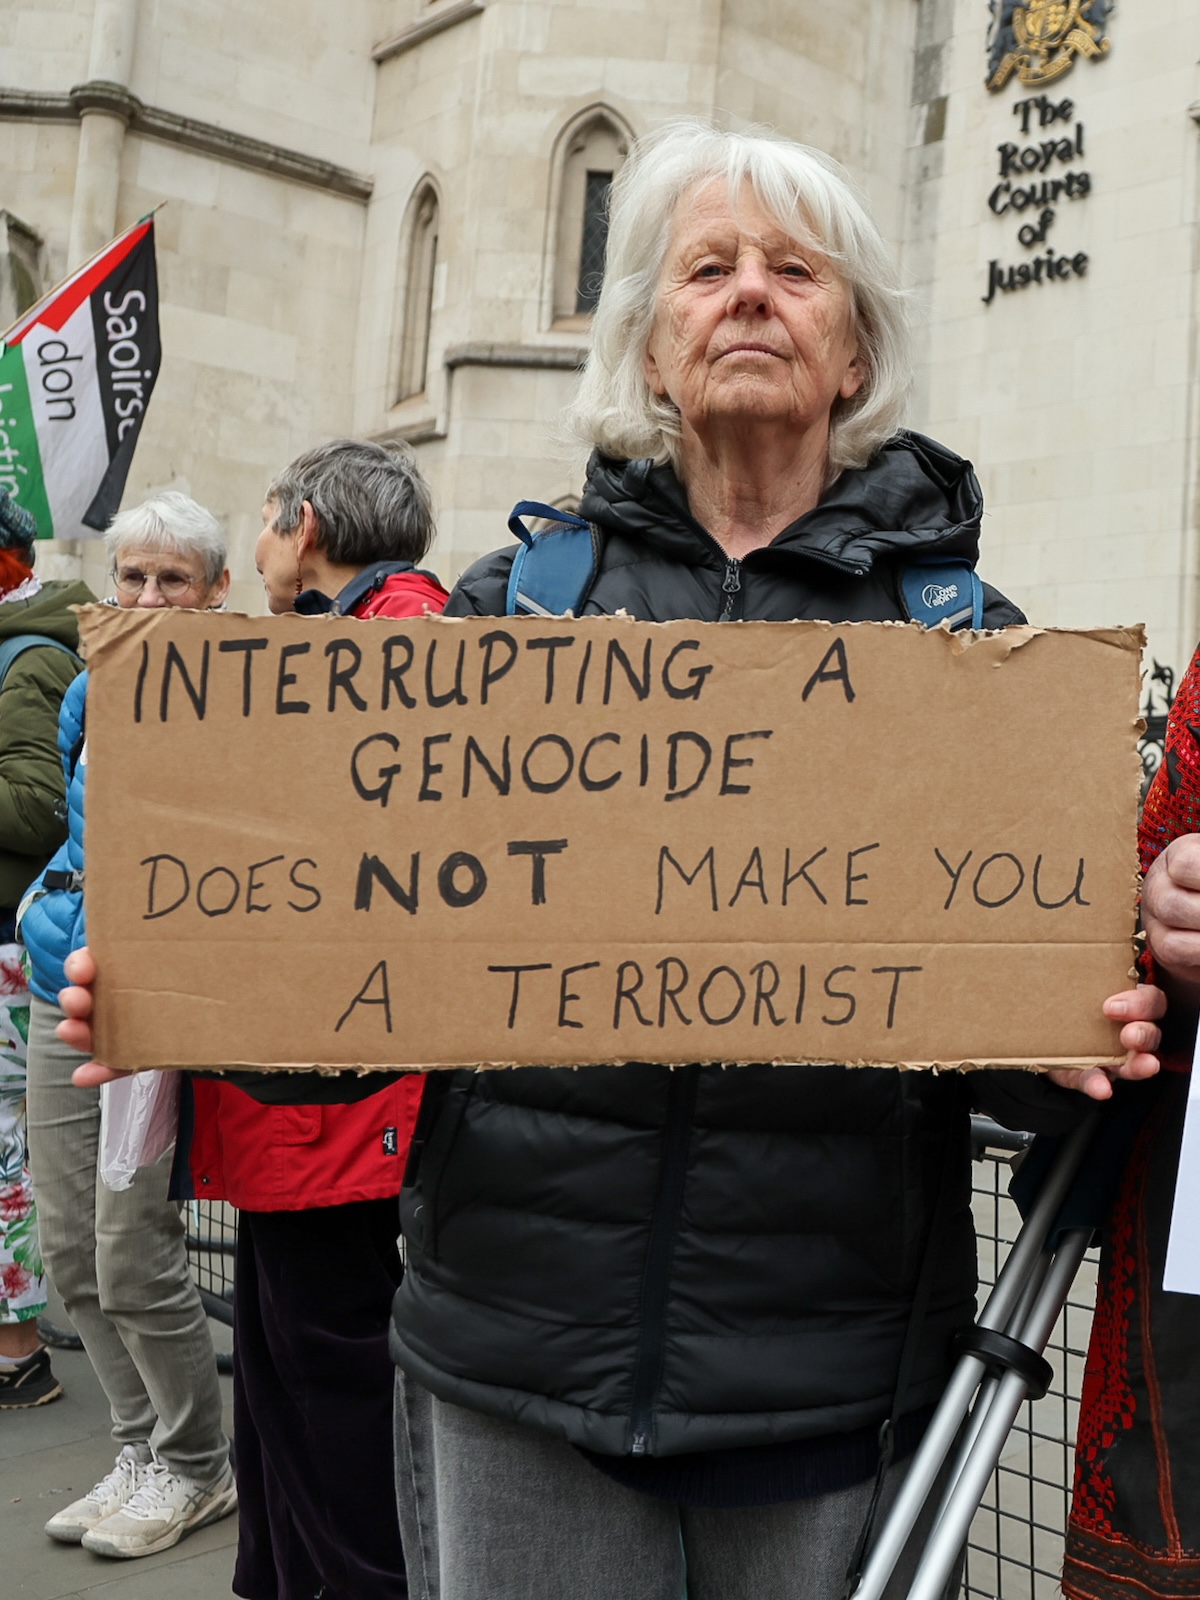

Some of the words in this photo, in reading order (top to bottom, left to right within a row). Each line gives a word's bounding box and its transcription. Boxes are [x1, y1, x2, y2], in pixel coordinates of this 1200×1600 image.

[1013, 95, 1074, 132] The
[998, 122, 1084, 178] Royal
[988, 171, 1091, 215] Courts
[1018, 207, 1055, 247] of
[981, 249, 1089, 306] Justice
[38, 340, 83, 421] don
[134, 630, 713, 723] INTERRUPTING
[802, 637, 855, 702] A
[350, 731, 773, 807] GENOCIDE
[141, 853, 321, 919] DOES
[354, 838, 568, 915] NOT
[655, 842, 880, 914] MAKE
[934, 848, 1090, 909] YOU
[335, 960, 392, 1032] A
[487, 957, 922, 1029] TERRORIST
